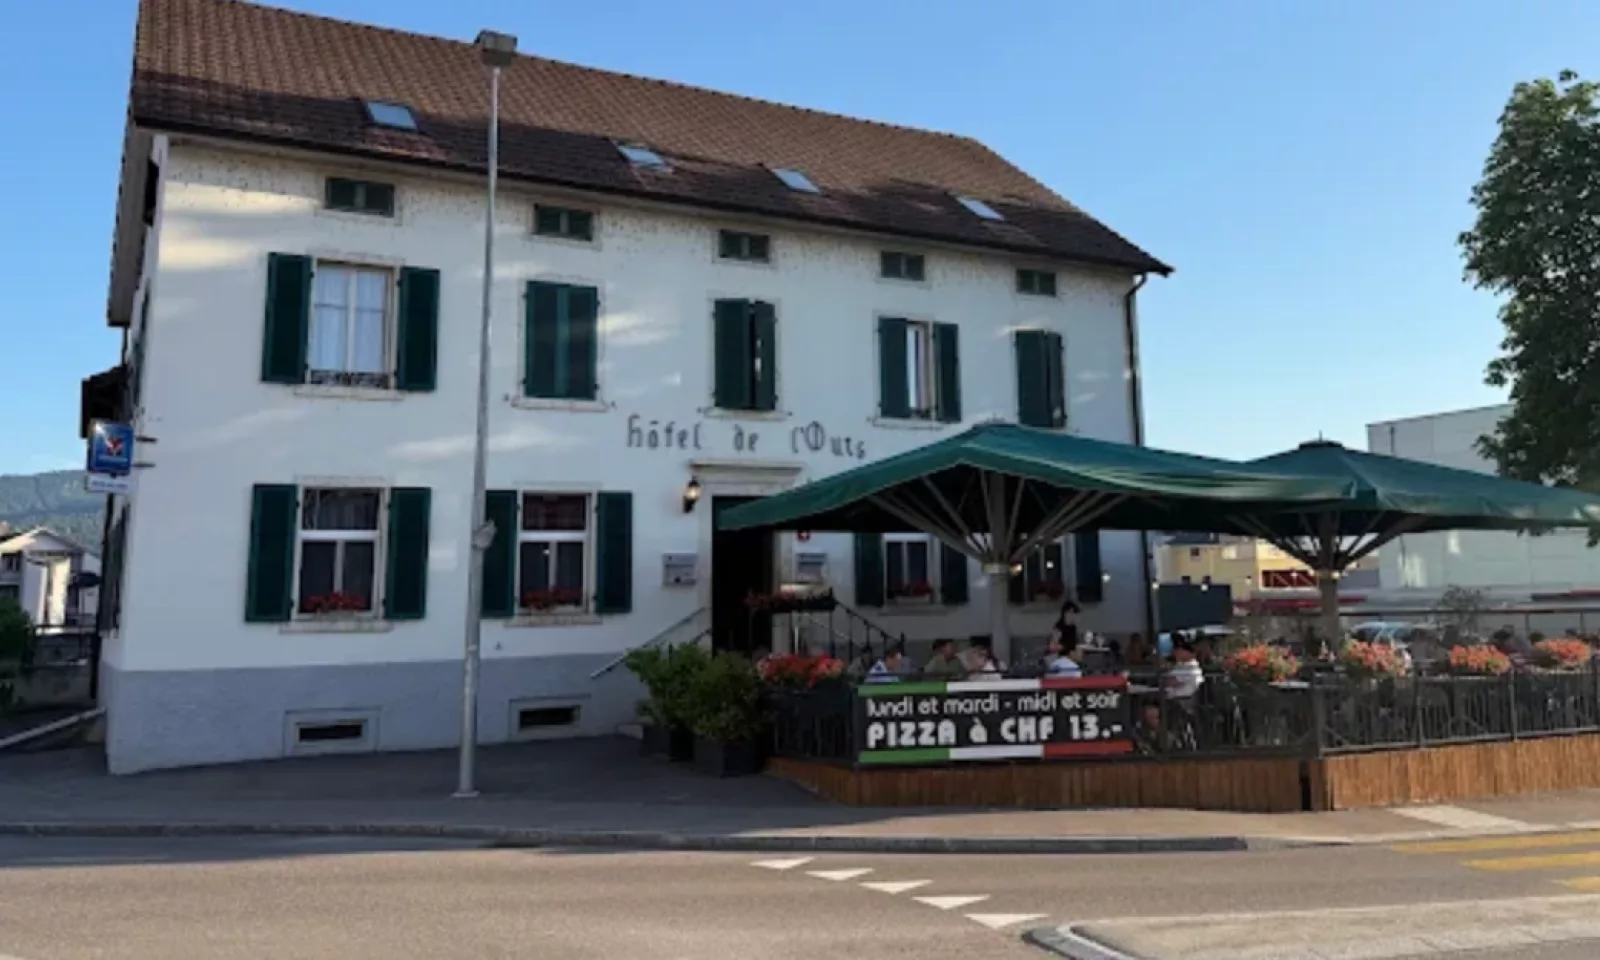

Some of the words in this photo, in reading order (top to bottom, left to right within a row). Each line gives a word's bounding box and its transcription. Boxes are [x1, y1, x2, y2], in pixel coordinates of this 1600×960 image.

[733, 424, 760, 452] de
[866, 695, 913, 717] lundi
[919, 696, 939, 714] et
[943, 693, 999, 713] mardi
[1018, 691, 1057, 711] midi
[1061, 692, 1081, 709] et
[1086, 690, 1120, 709] soir
[867, 719, 957, 748] PIZZA
[969, 716, 988, 743] à
[1000, 715, 1054, 741] CHF
[1069, 714, 1123, 740] 13.-
